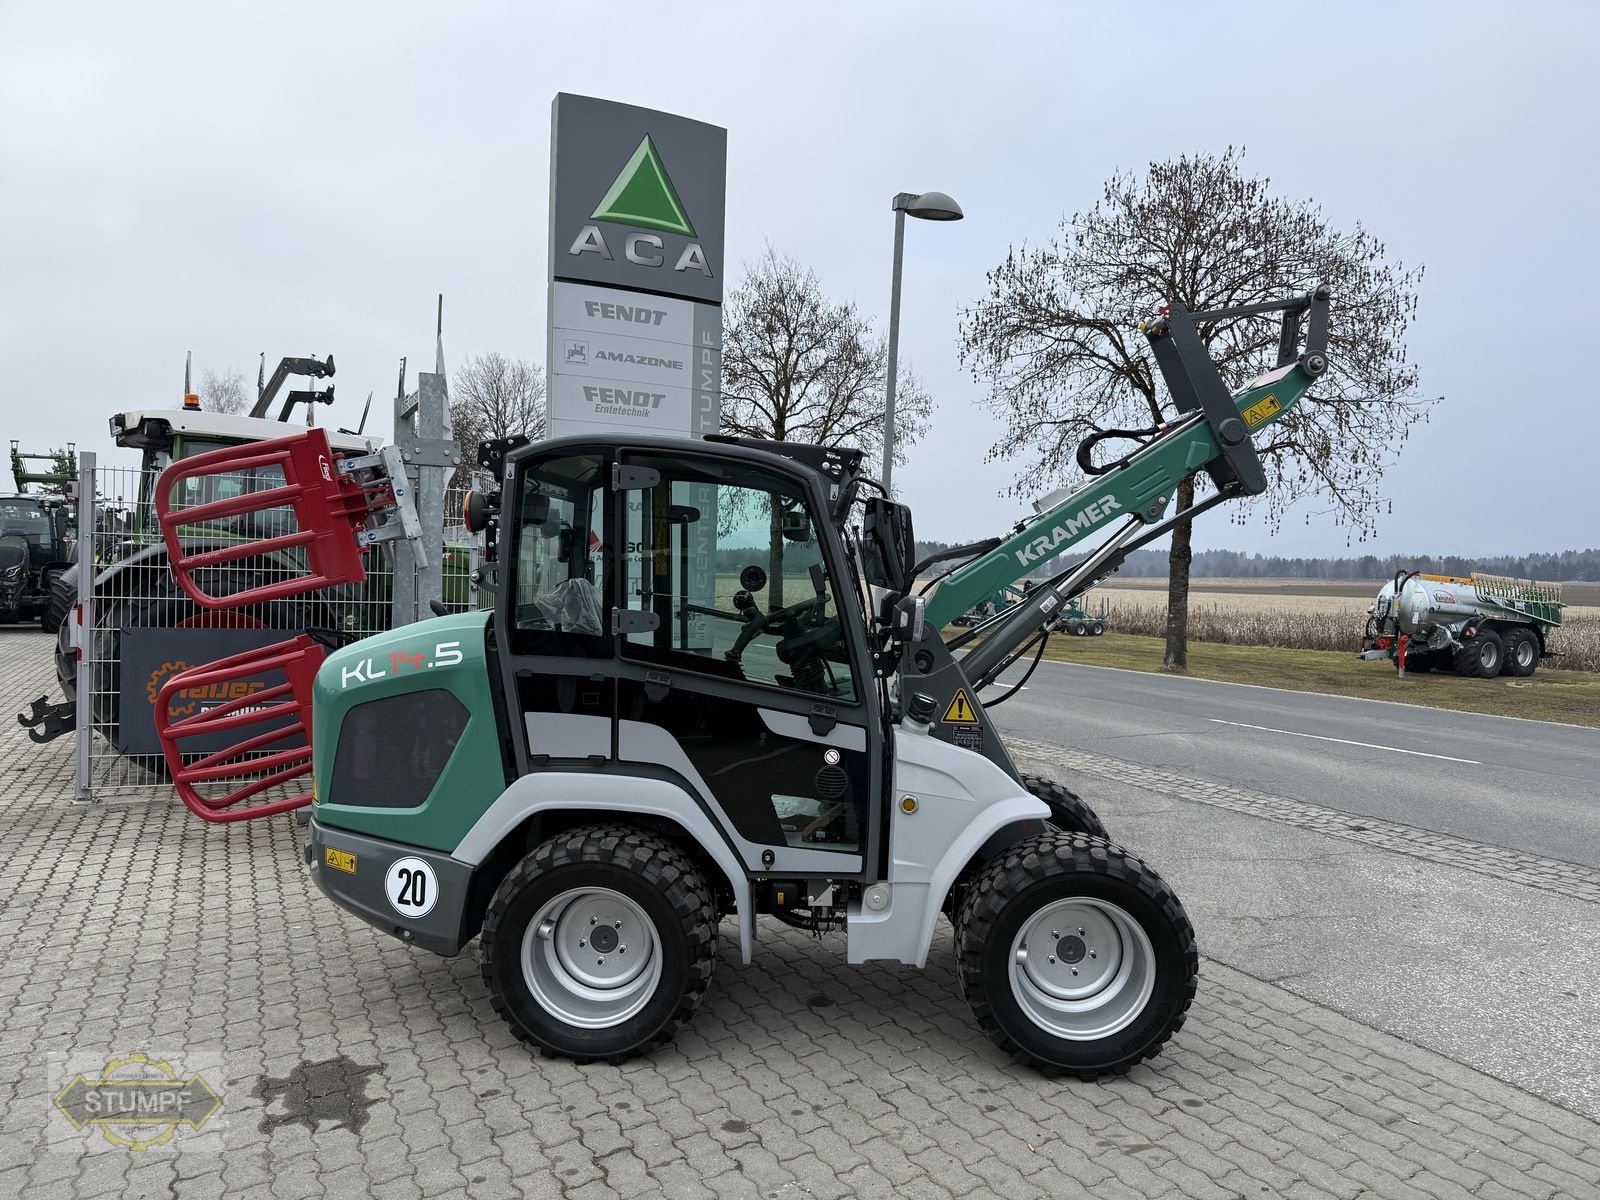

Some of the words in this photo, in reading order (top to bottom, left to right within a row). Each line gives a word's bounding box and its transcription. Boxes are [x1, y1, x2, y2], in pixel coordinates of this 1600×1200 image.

[568, 225, 714, 278] ACA
[584, 300, 668, 326] FENDT
[594, 350, 684, 370] AMAZONE
[582, 385, 666, 409] FENDT
[700, 330, 714, 440] TUMPF
[594, 403, 651, 418] Erntetechnik
[696, 487, 710, 589] CENTER
[1015, 494, 1122, 567] KRAMER
[397, 867, 427, 907] 20
